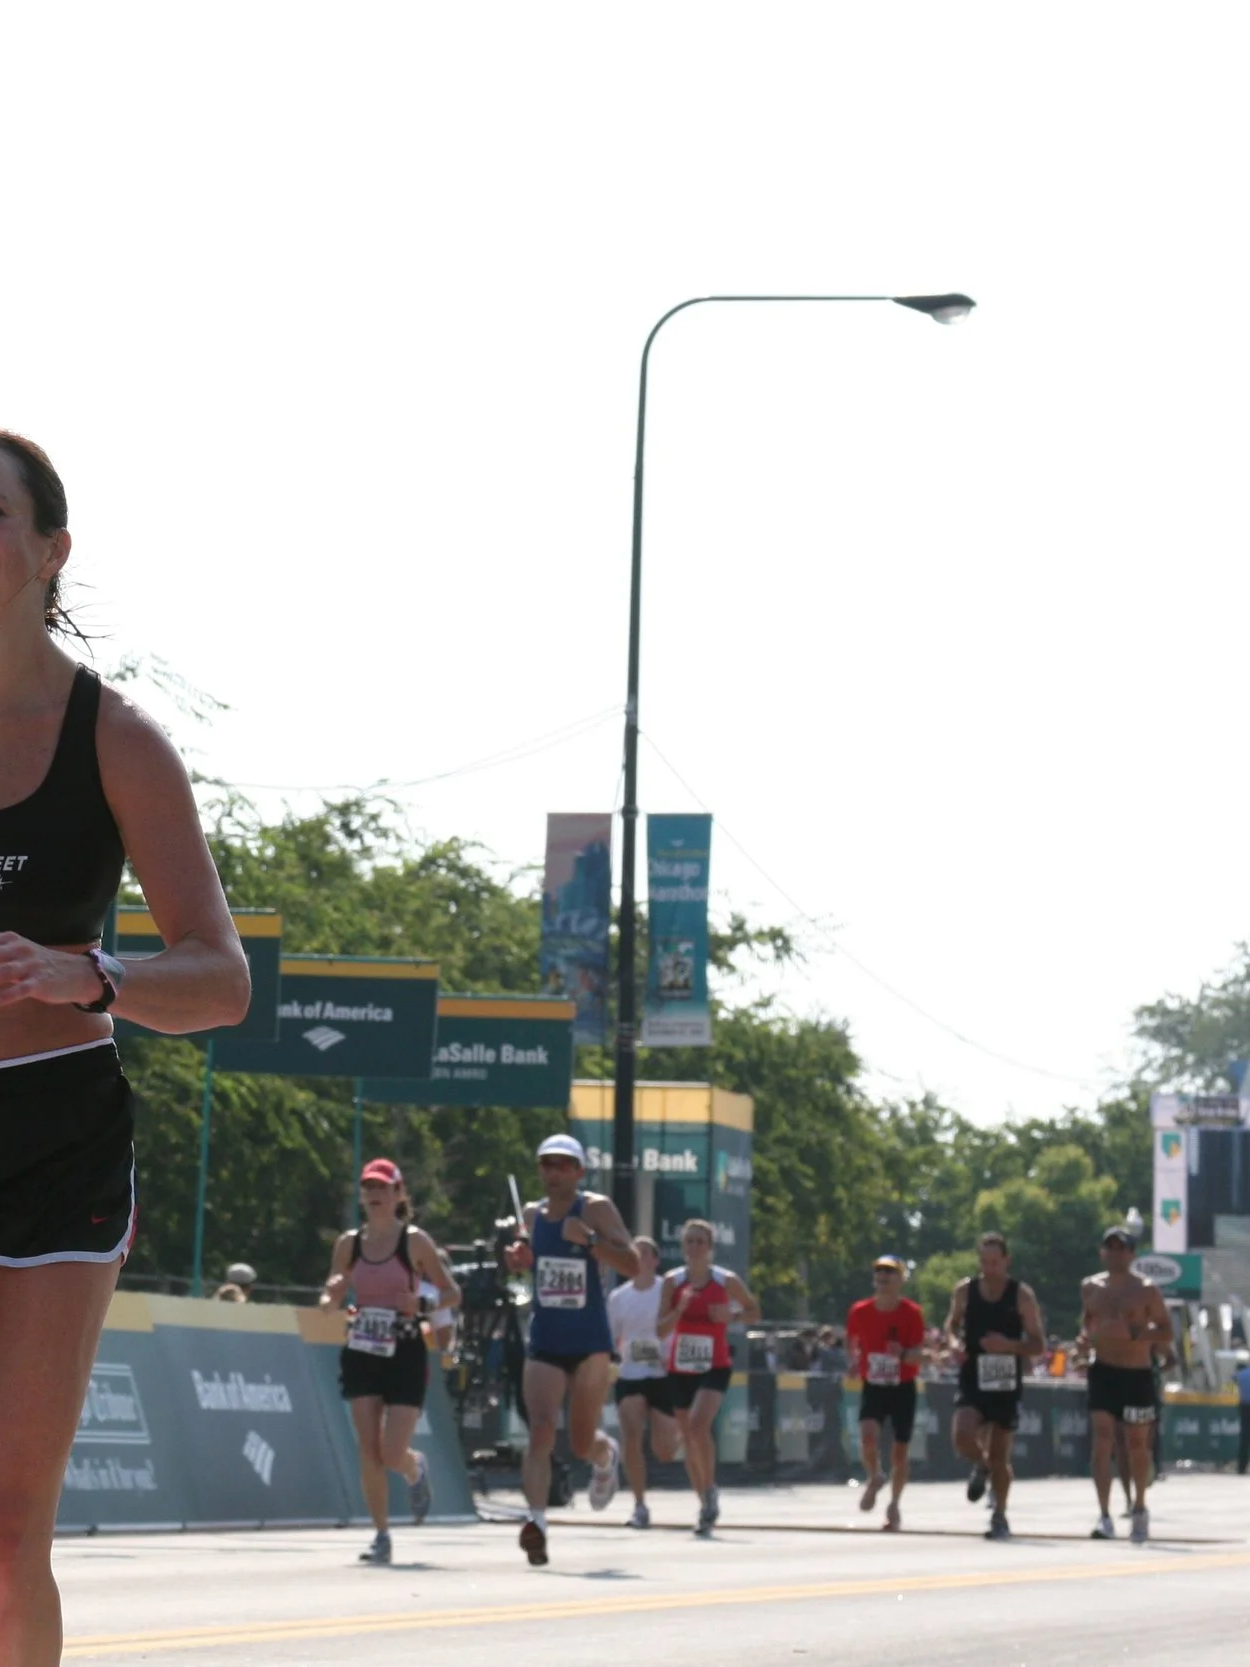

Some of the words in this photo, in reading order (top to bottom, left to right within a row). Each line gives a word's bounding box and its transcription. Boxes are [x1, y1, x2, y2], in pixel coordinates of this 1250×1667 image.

[304, 1001, 322, 1019] of
[326, 1003, 393, 1022] America
[501, 1045, 548, 1066] Bank
[643, 1149, 698, 1172] Bank
